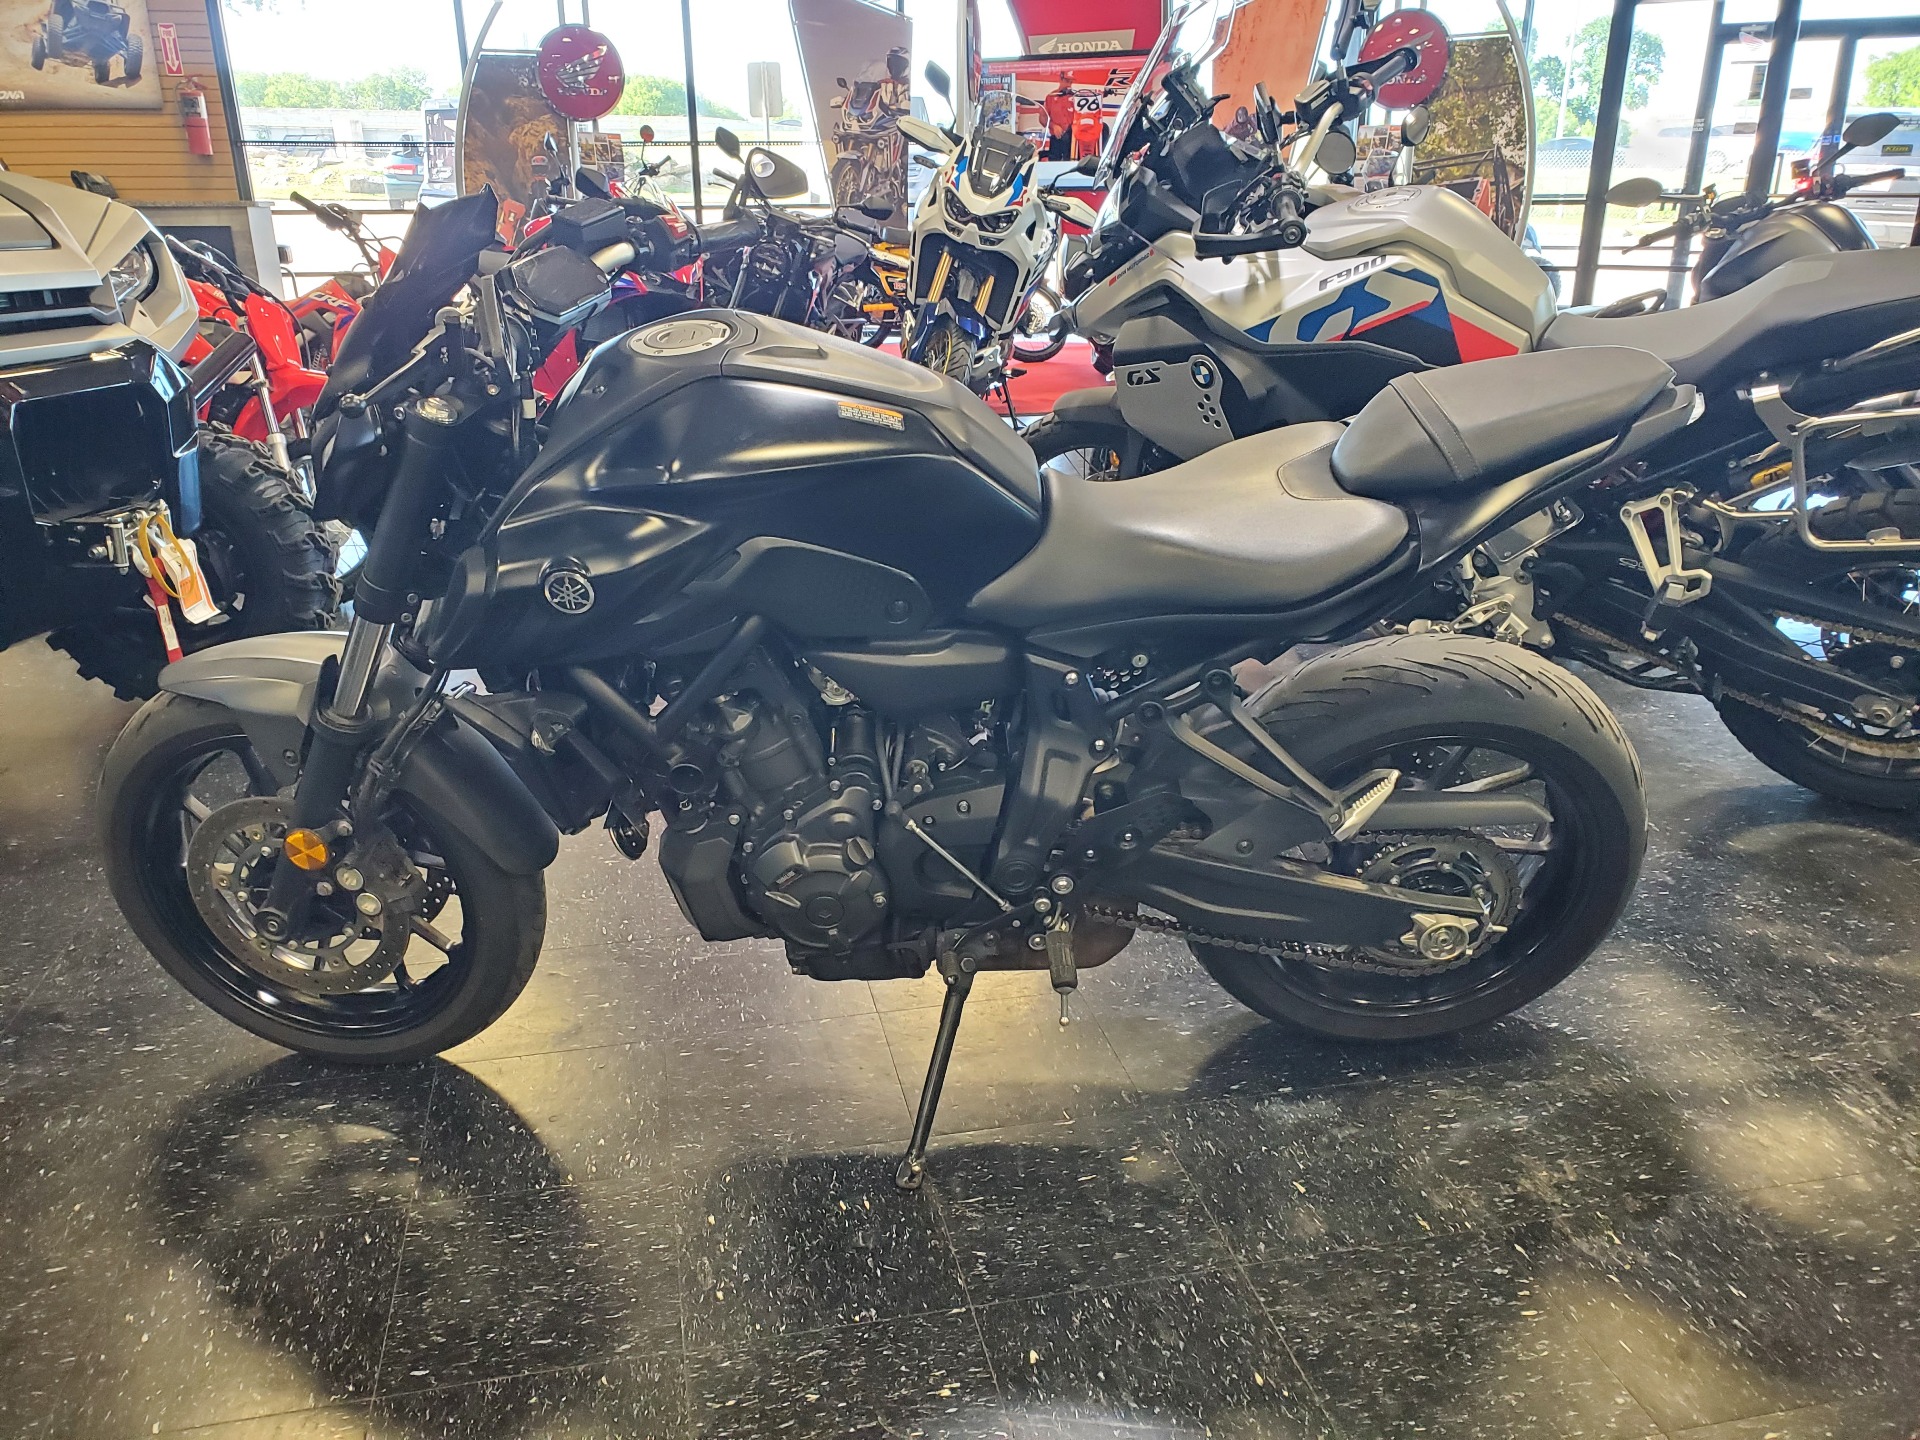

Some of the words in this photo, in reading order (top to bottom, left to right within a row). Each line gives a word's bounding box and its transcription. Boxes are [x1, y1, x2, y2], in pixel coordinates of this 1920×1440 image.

[1057, 40, 1123, 53] HONDA
[1077, 98, 1100, 111] 96
[1318, 254, 1387, 292] F900
[1127, 367, 1161, 386] GS
